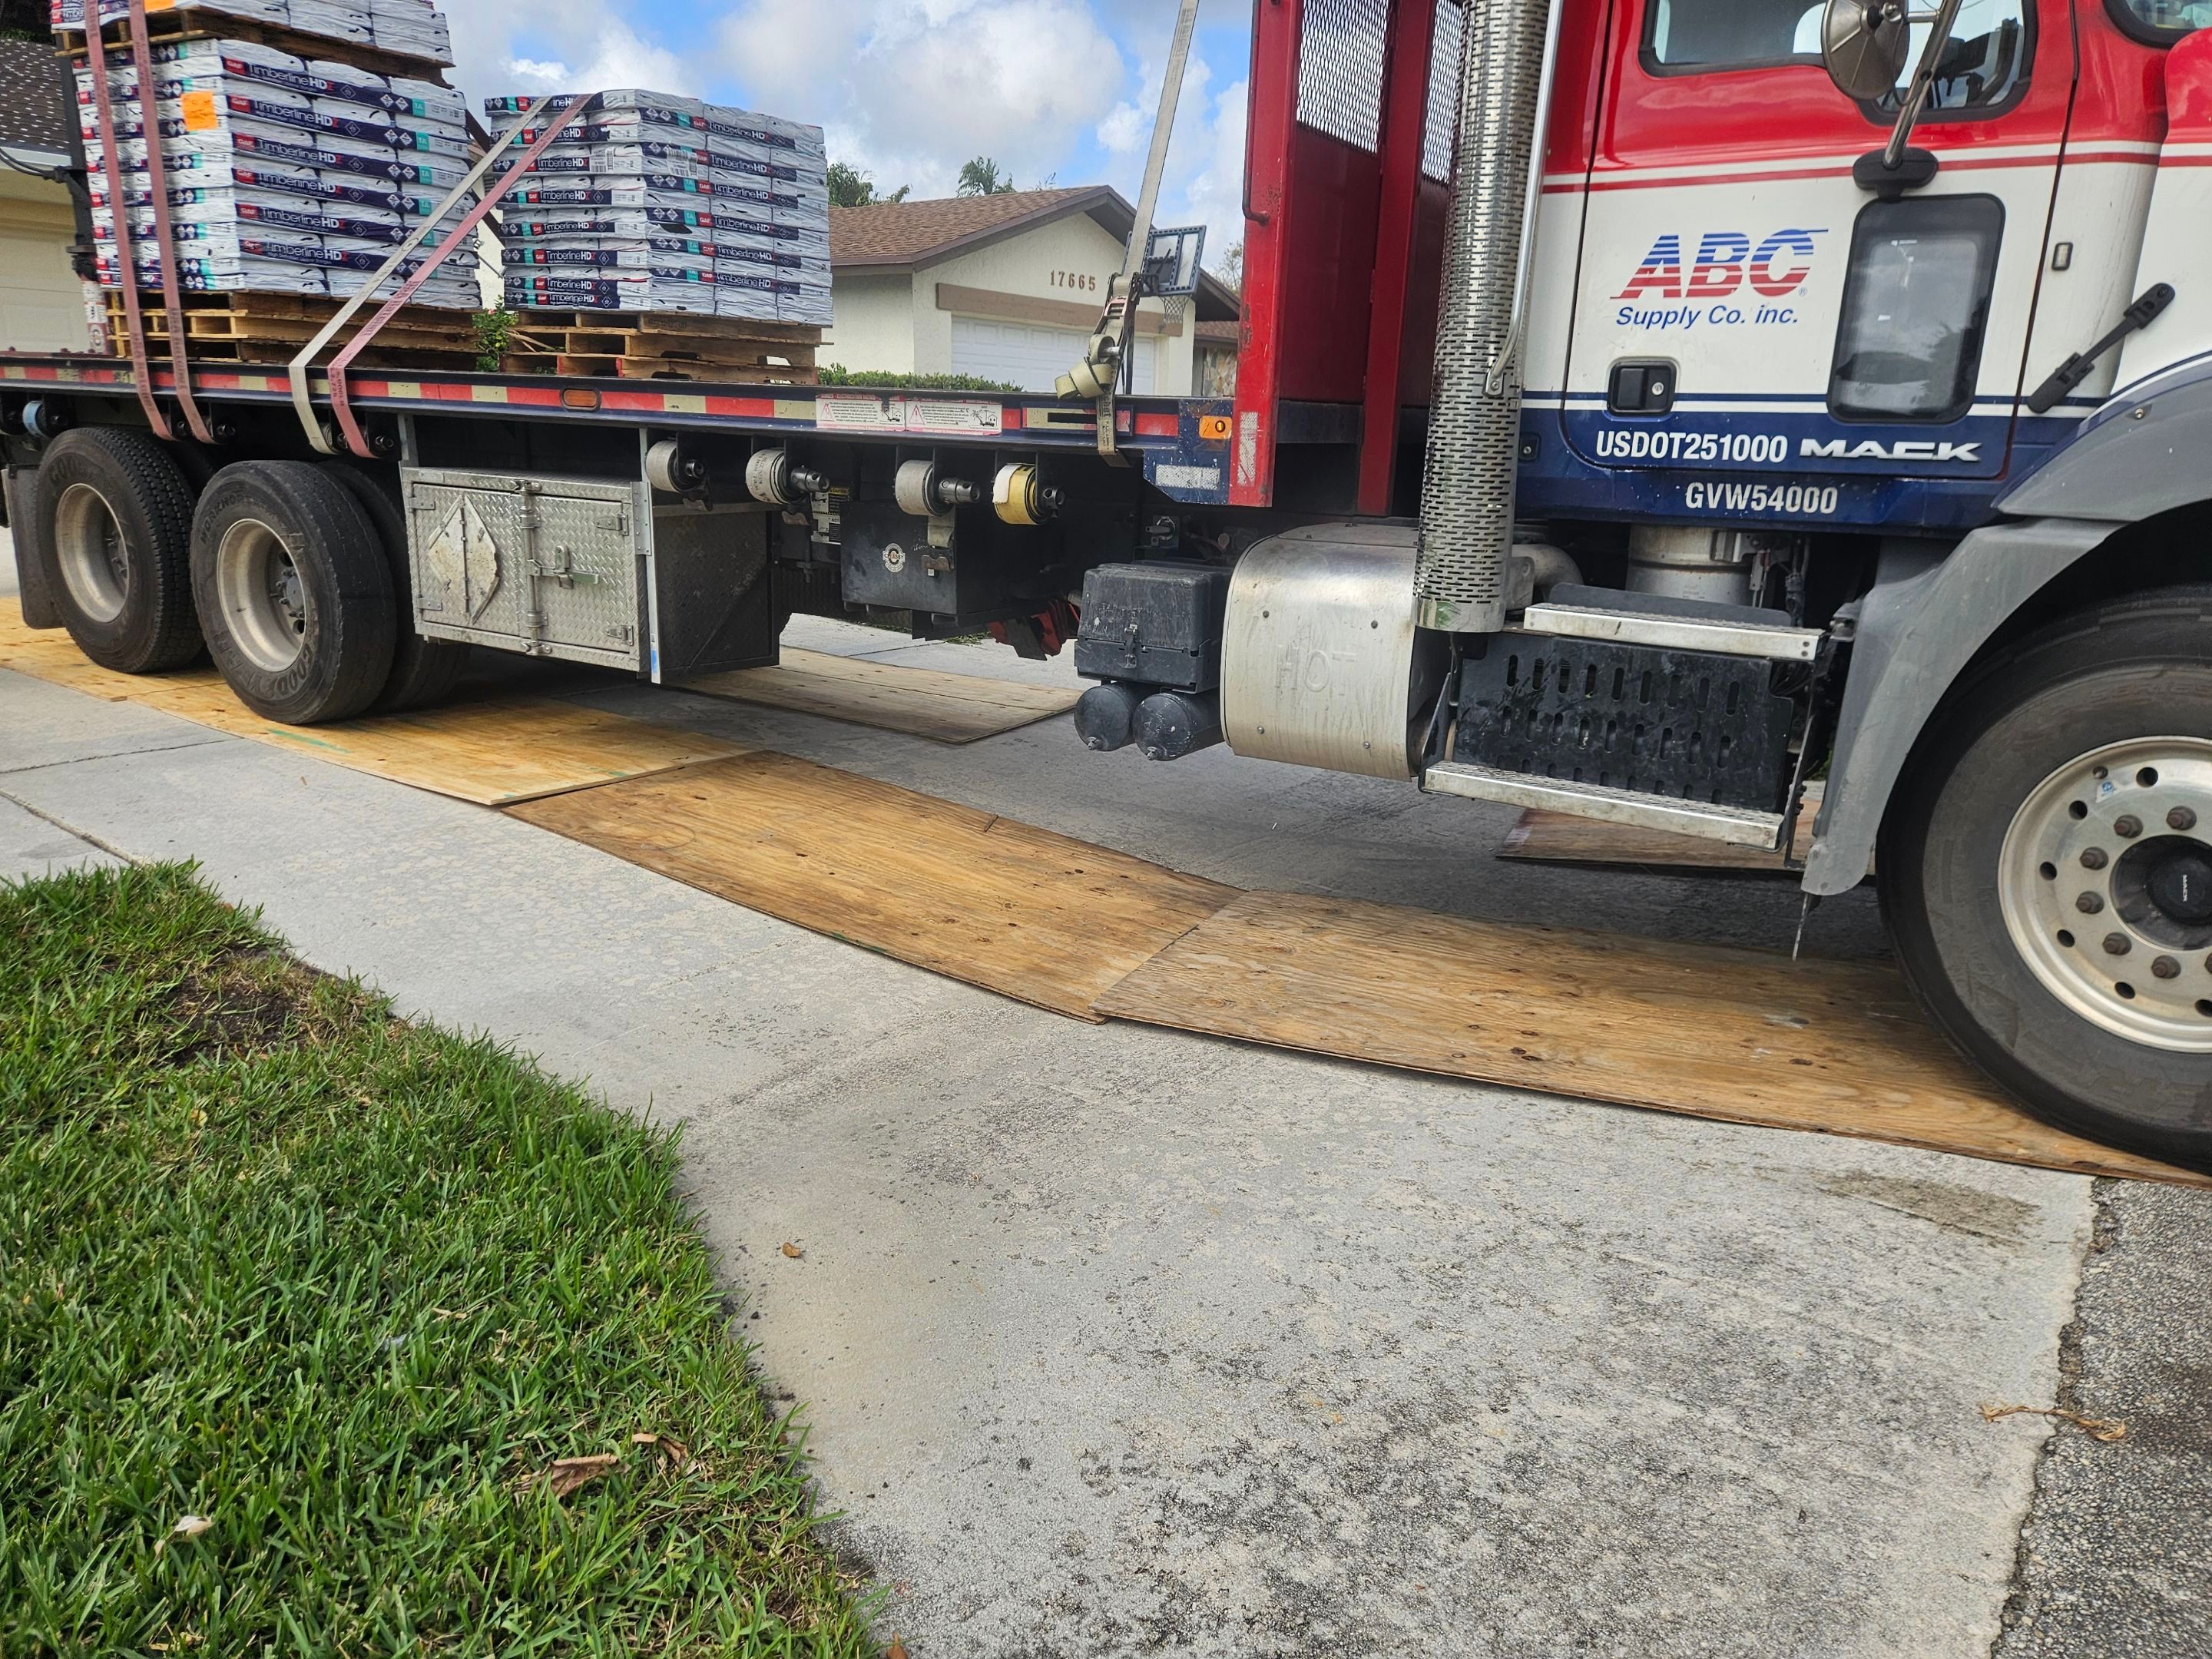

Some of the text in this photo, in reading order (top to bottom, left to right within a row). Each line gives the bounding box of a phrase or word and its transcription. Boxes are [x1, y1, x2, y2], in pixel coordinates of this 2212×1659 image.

[1610, 228, 1829, 300] ABC
[1050, 270, 1096, 292] 17665
[1616, 304, 1799, 329] Supply Co. inc.
[1595, 431, 1788, 463] USDOT251000
[1800, 439, 1982, 462] MACK
[1685, 482, 1839, 515] GVW54000
